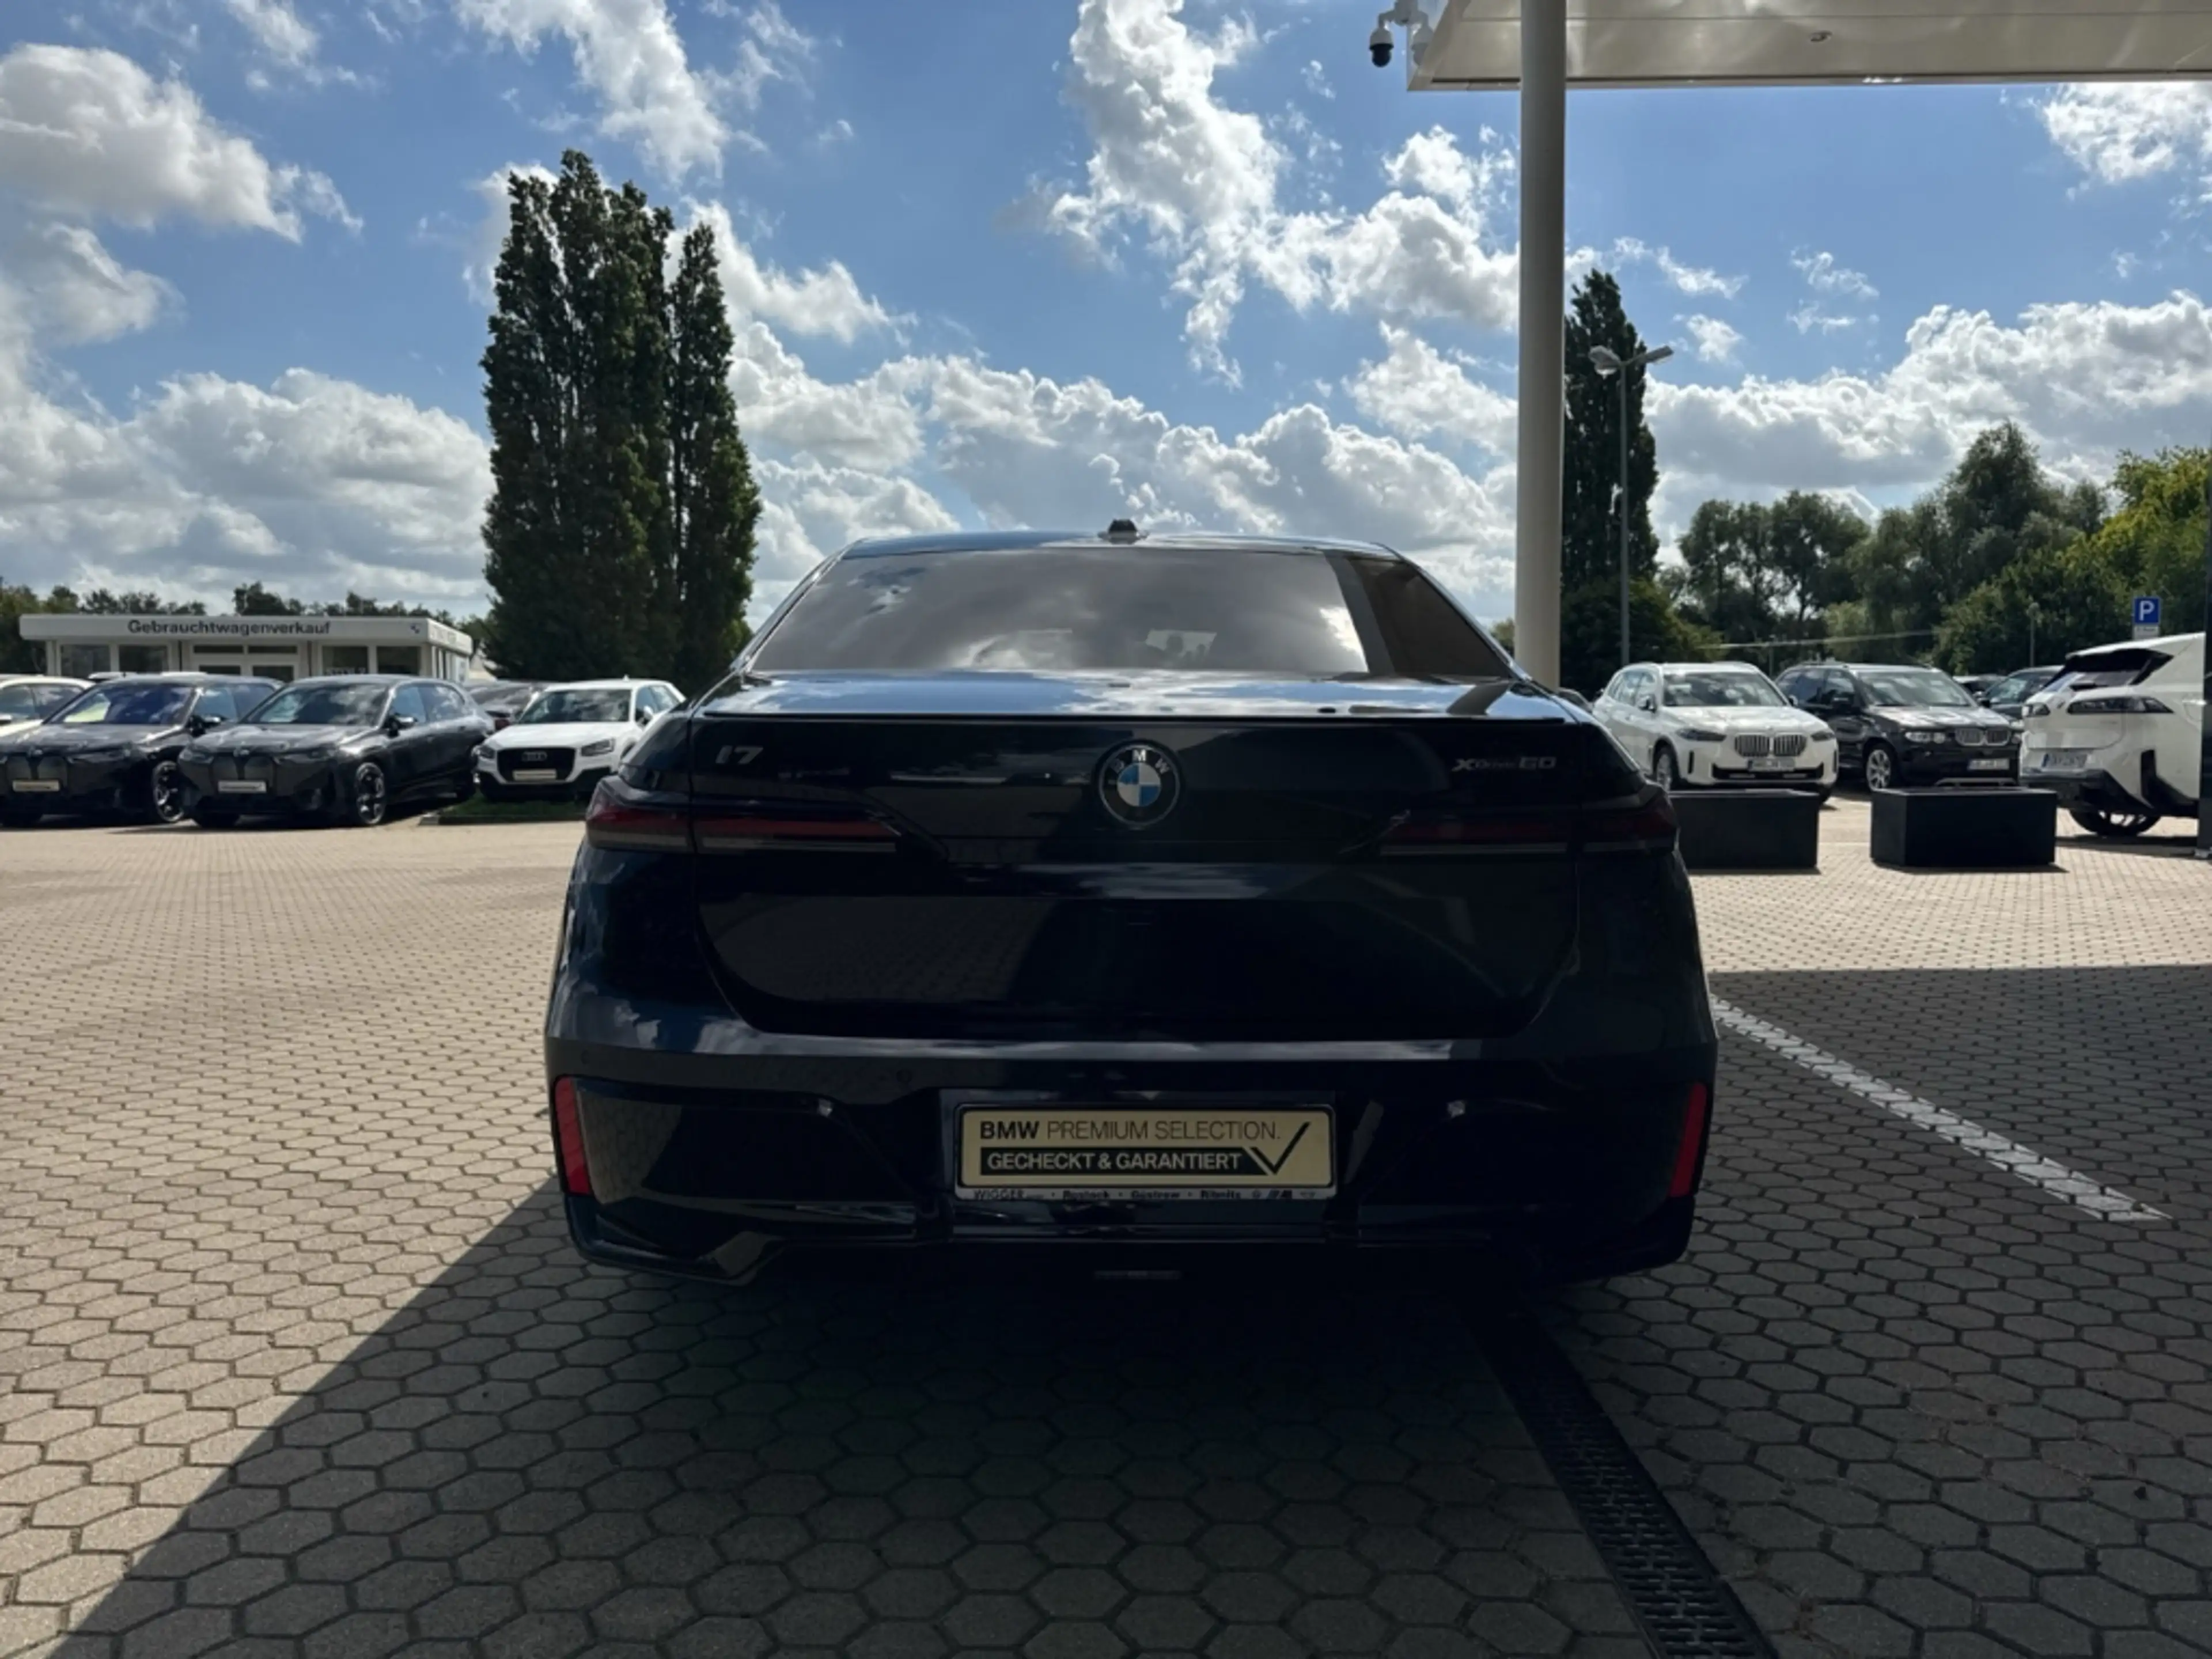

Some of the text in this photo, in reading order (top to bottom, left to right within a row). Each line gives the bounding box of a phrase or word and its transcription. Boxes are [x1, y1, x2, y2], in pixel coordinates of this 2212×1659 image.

[2139, 600, 2155, 621] P
[127, 619, 331, 636] Gebrauchtwagenverkauf
[1109, 748, 1171, 775] BMW
[980, 1121, 1281, 1140] BMW PREMIUM SELECTION.
[987, 1152, 1242, 1171] GECHECKT & GARANTIERT
